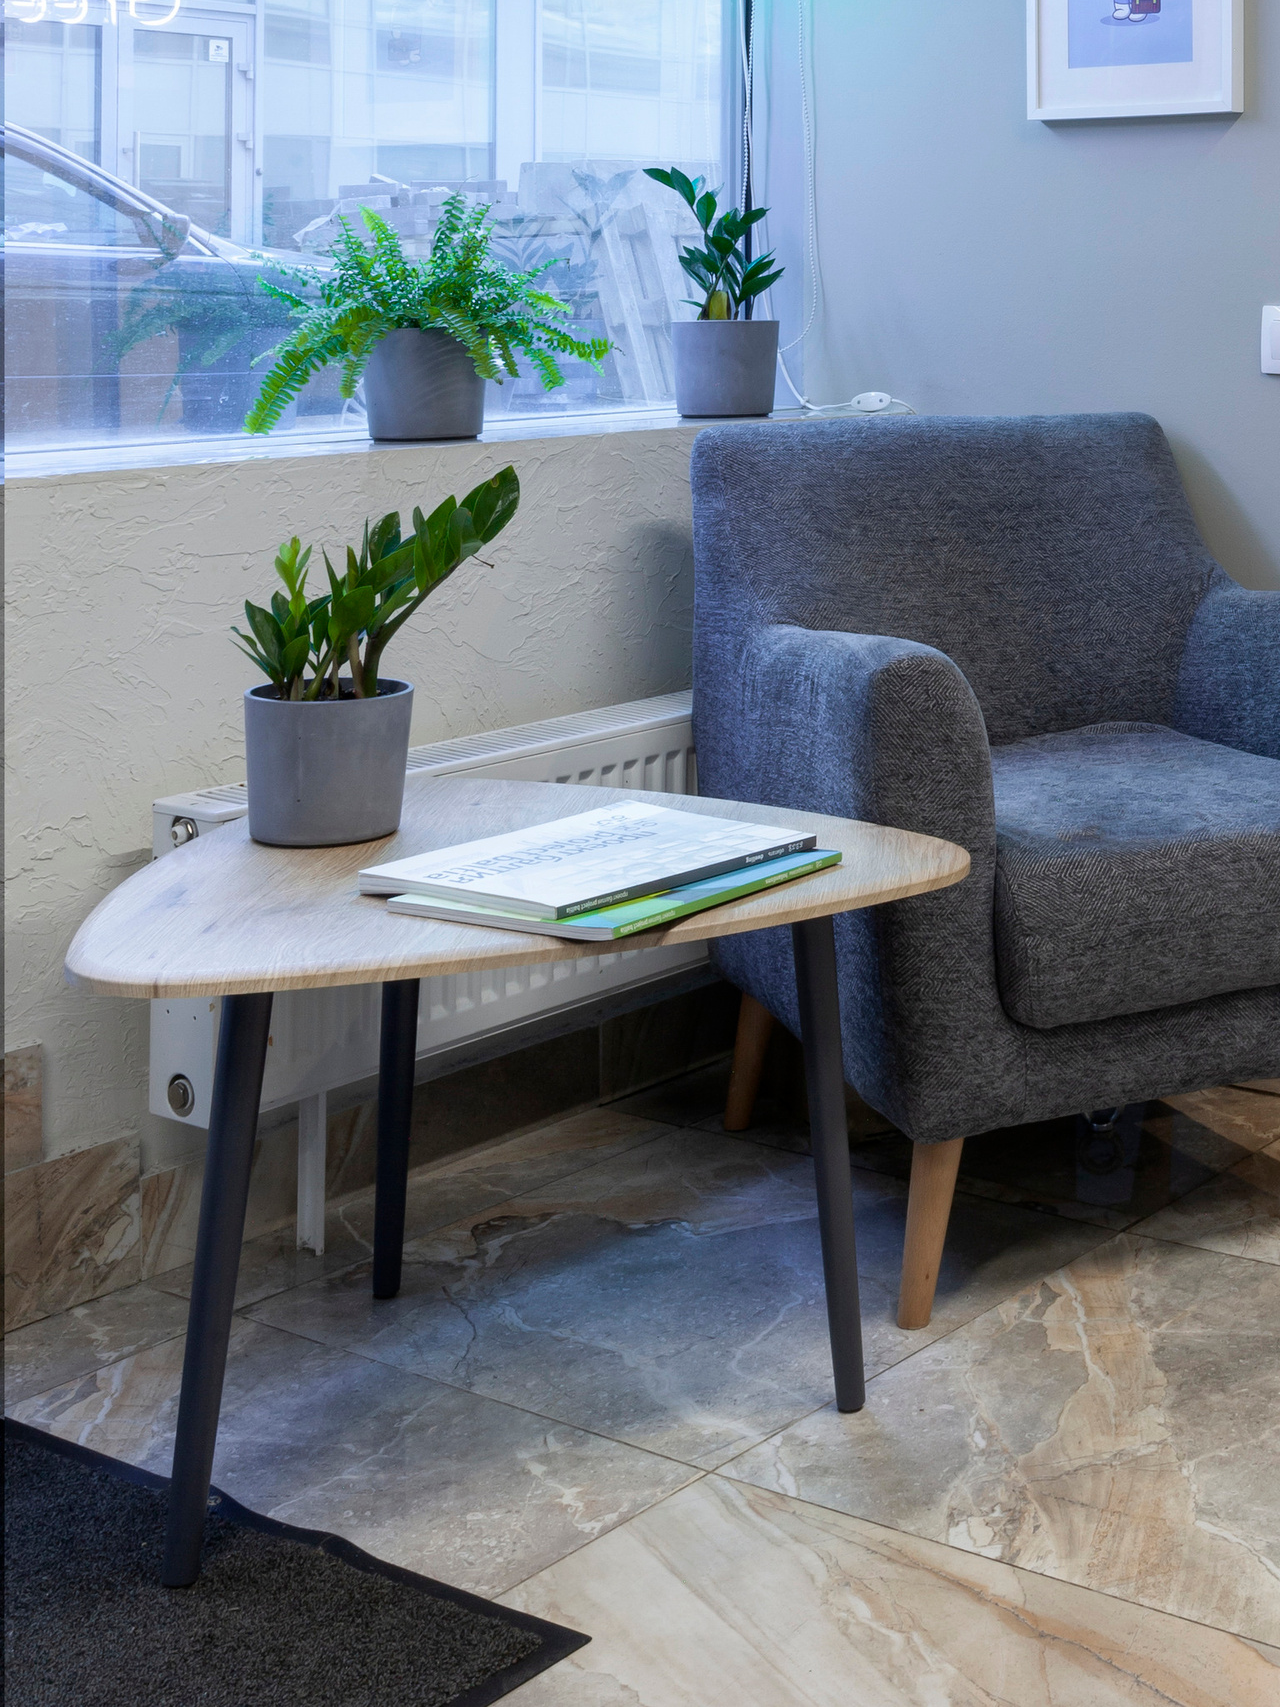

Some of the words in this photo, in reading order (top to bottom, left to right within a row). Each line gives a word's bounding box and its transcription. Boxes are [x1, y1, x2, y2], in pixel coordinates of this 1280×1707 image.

[514, 830, 617, 856] project
[558, 830, 658, 856] проект
[423, 854, 525, 879] baltia
[448, 855, 562, 883] балтия
